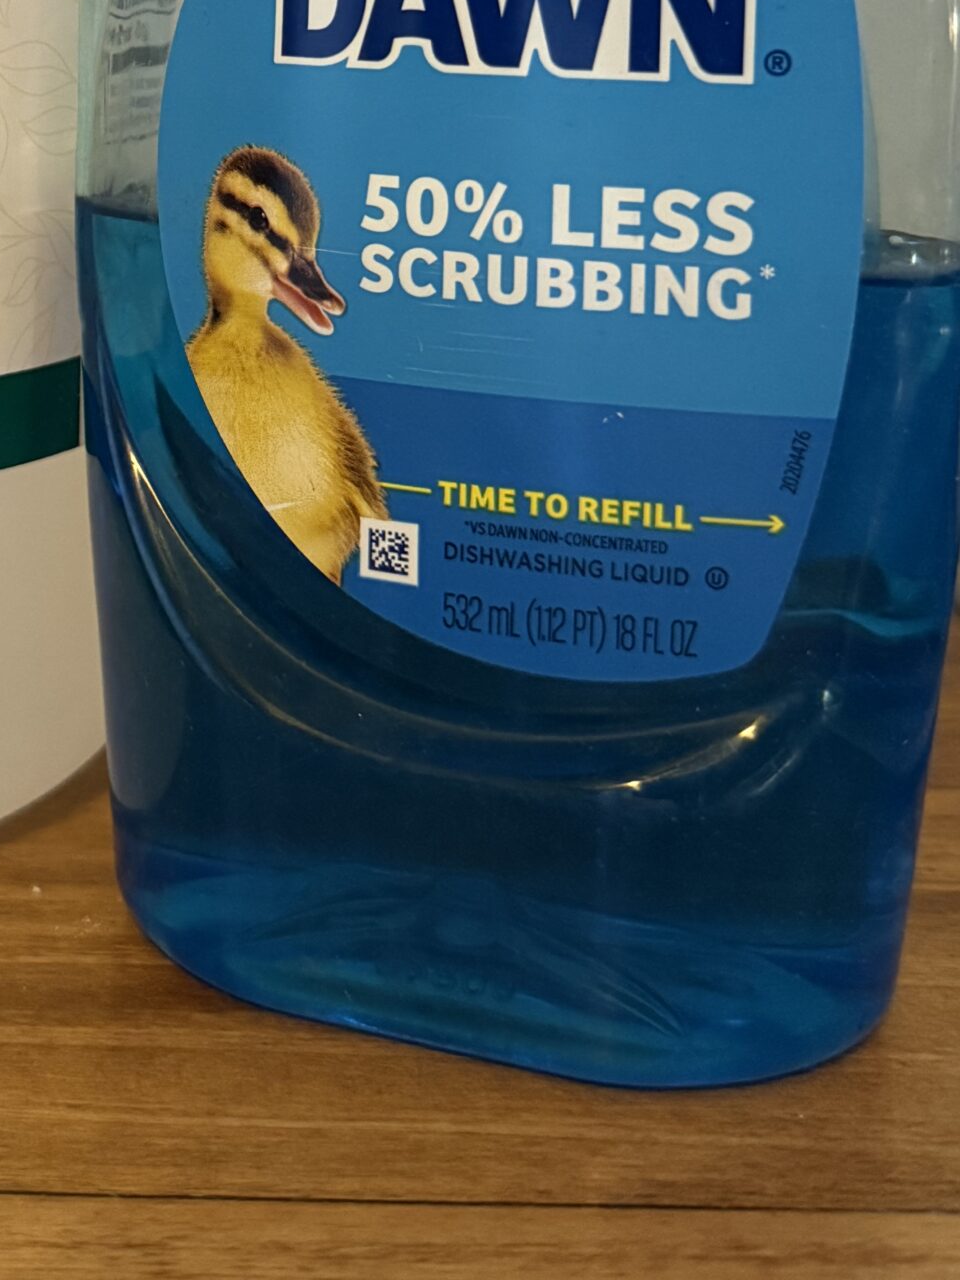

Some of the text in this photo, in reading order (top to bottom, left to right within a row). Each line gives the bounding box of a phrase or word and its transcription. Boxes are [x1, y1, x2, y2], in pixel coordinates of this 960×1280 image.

[360, 173, 756, 256] 50% LESS
[438, 480, 695, 532] TIME TO REFILL
[443, 541, 690, 587] DISHWASHING LIQUID
[487, 522, 530, 541] DAWN
[530, 528, 669, 555] NON-CONCENTRATED
[442, 592, 698, 658] 532 mL (1.12 PT) 18 FL OZ
